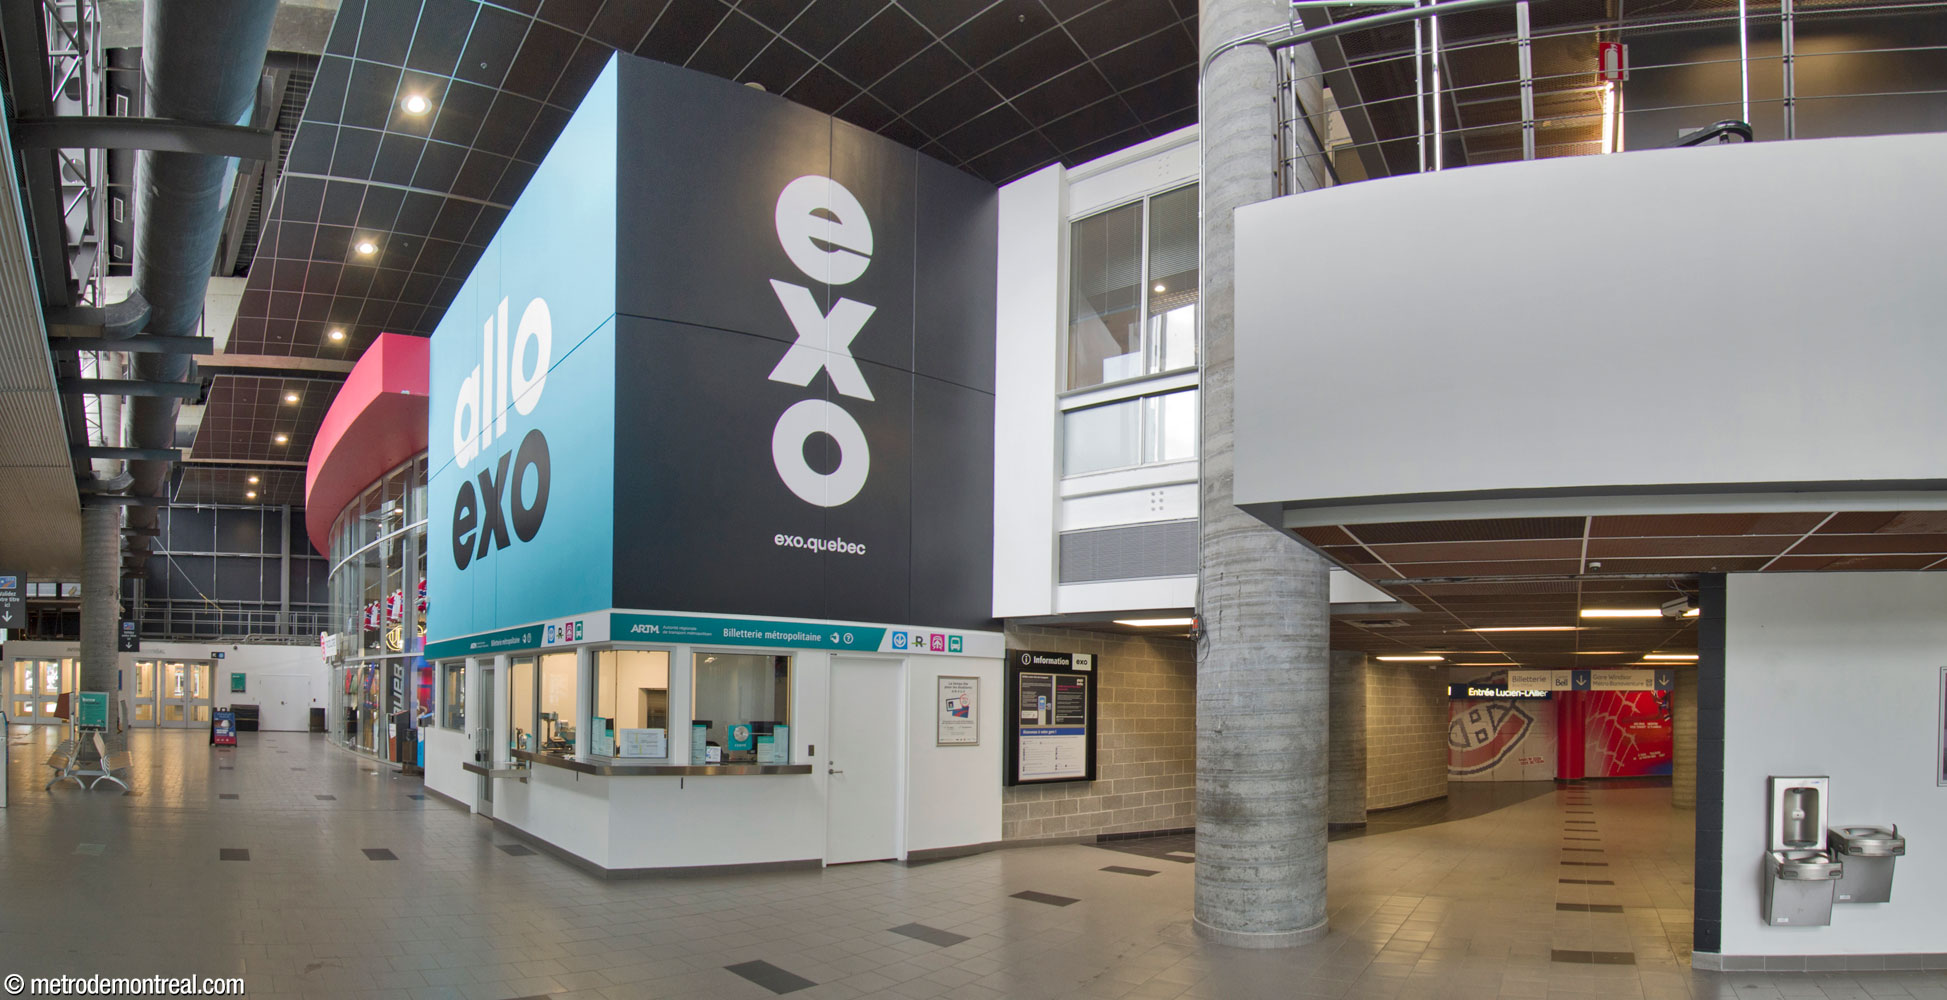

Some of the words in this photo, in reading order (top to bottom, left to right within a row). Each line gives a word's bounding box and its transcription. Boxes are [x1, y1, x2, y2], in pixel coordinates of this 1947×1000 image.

[767, 174, 877, 508] exo
[453, 295, 552, 469] allo
[452, 429, 551, 571] exo
[774, 534, 866, 555] exo.quebec
[630, 624, 660, 634] ARTM
[723, 628, 763, 639] Billetterie
[764, 630, 822, 642] métropolitaine
[1033, 656, 1070, 666] Information
[1512, 675, 1547, 683] Billetterie
[1555, 679, 1569, 687] Bell
[1468, 687, 1495, 697] Entrée
